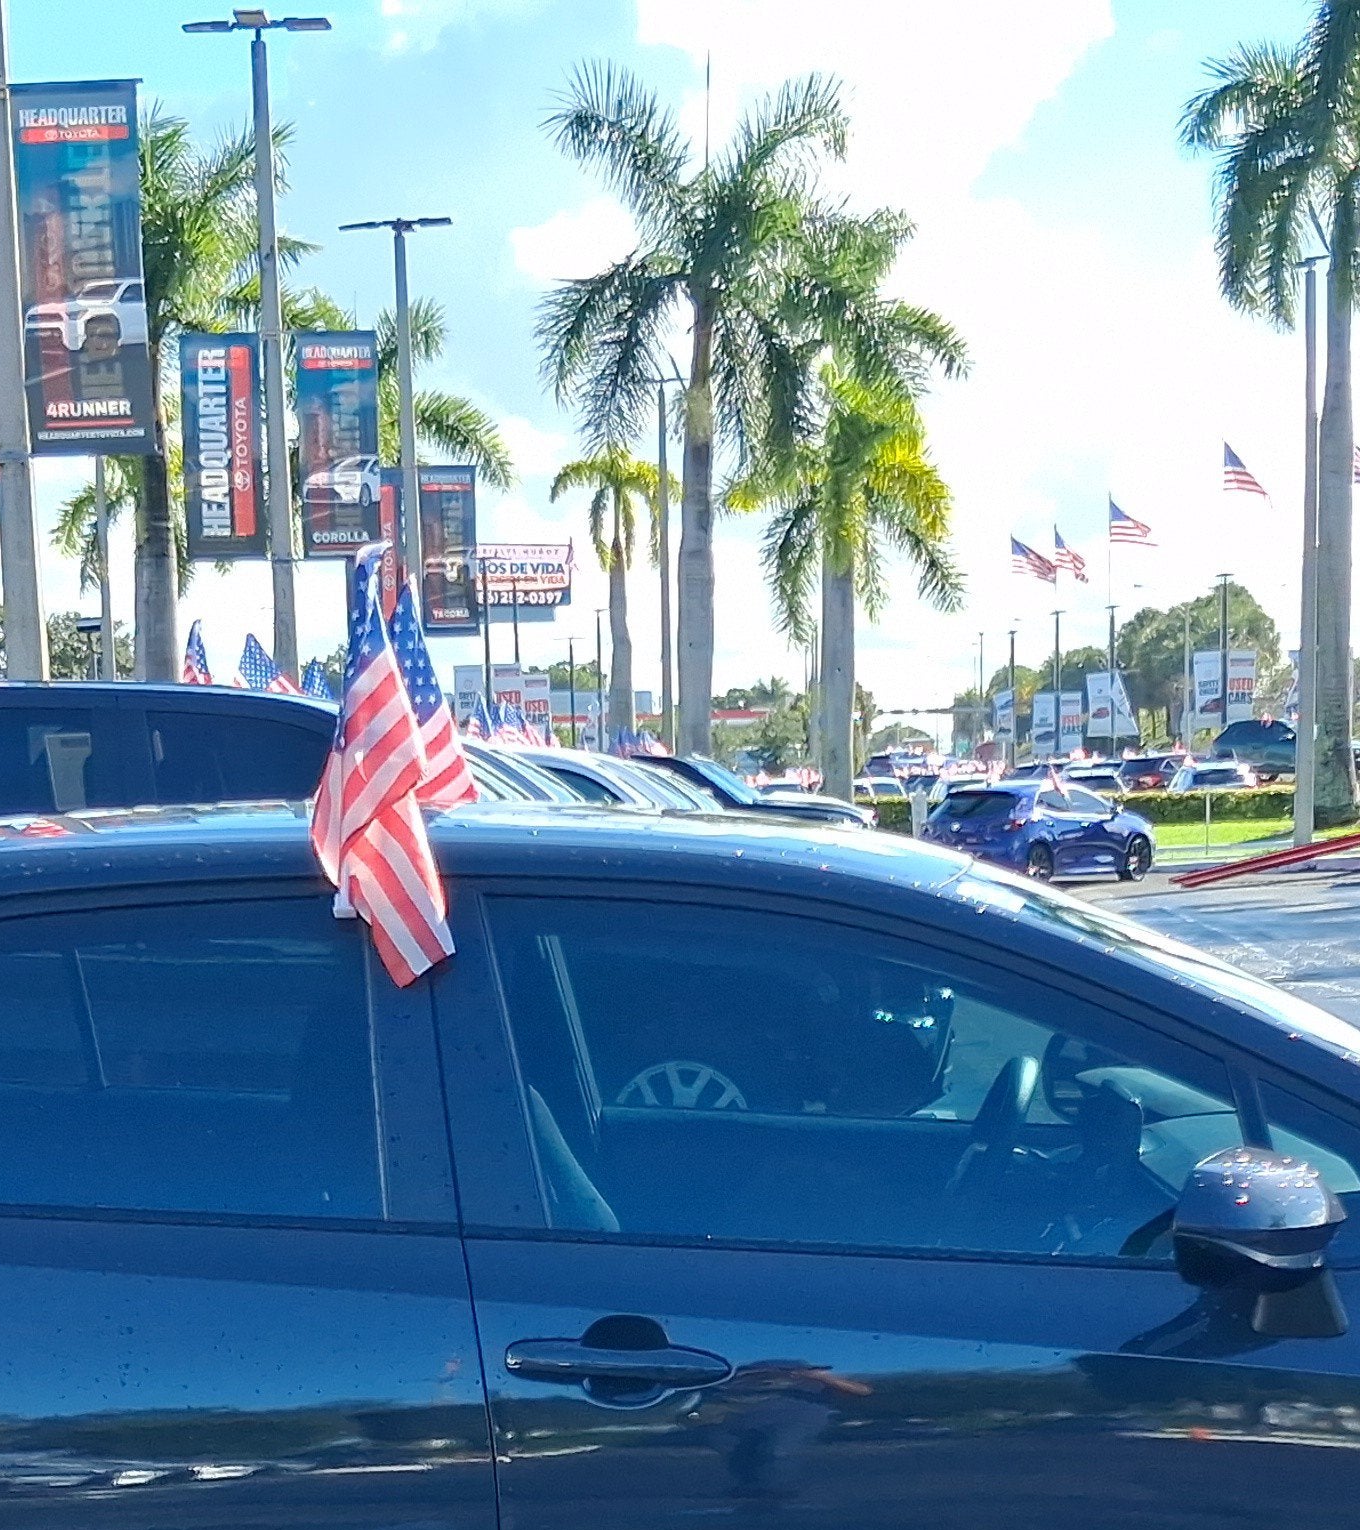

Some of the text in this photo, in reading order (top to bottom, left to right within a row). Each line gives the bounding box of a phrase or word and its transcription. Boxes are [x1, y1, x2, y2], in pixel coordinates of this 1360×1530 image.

[19, 106, 128, 128] HEADQUARTER
[45, 399, 132, 418] 4RUNNER
[235, 396, 250, 466] TOYOTA
[198, 348, 232, 538] HEADQUARTER
[312, 531, 371, 544] COROLLA
[510, 562, 527, 574] DE
[530, 562, 565, 574] VIDA
